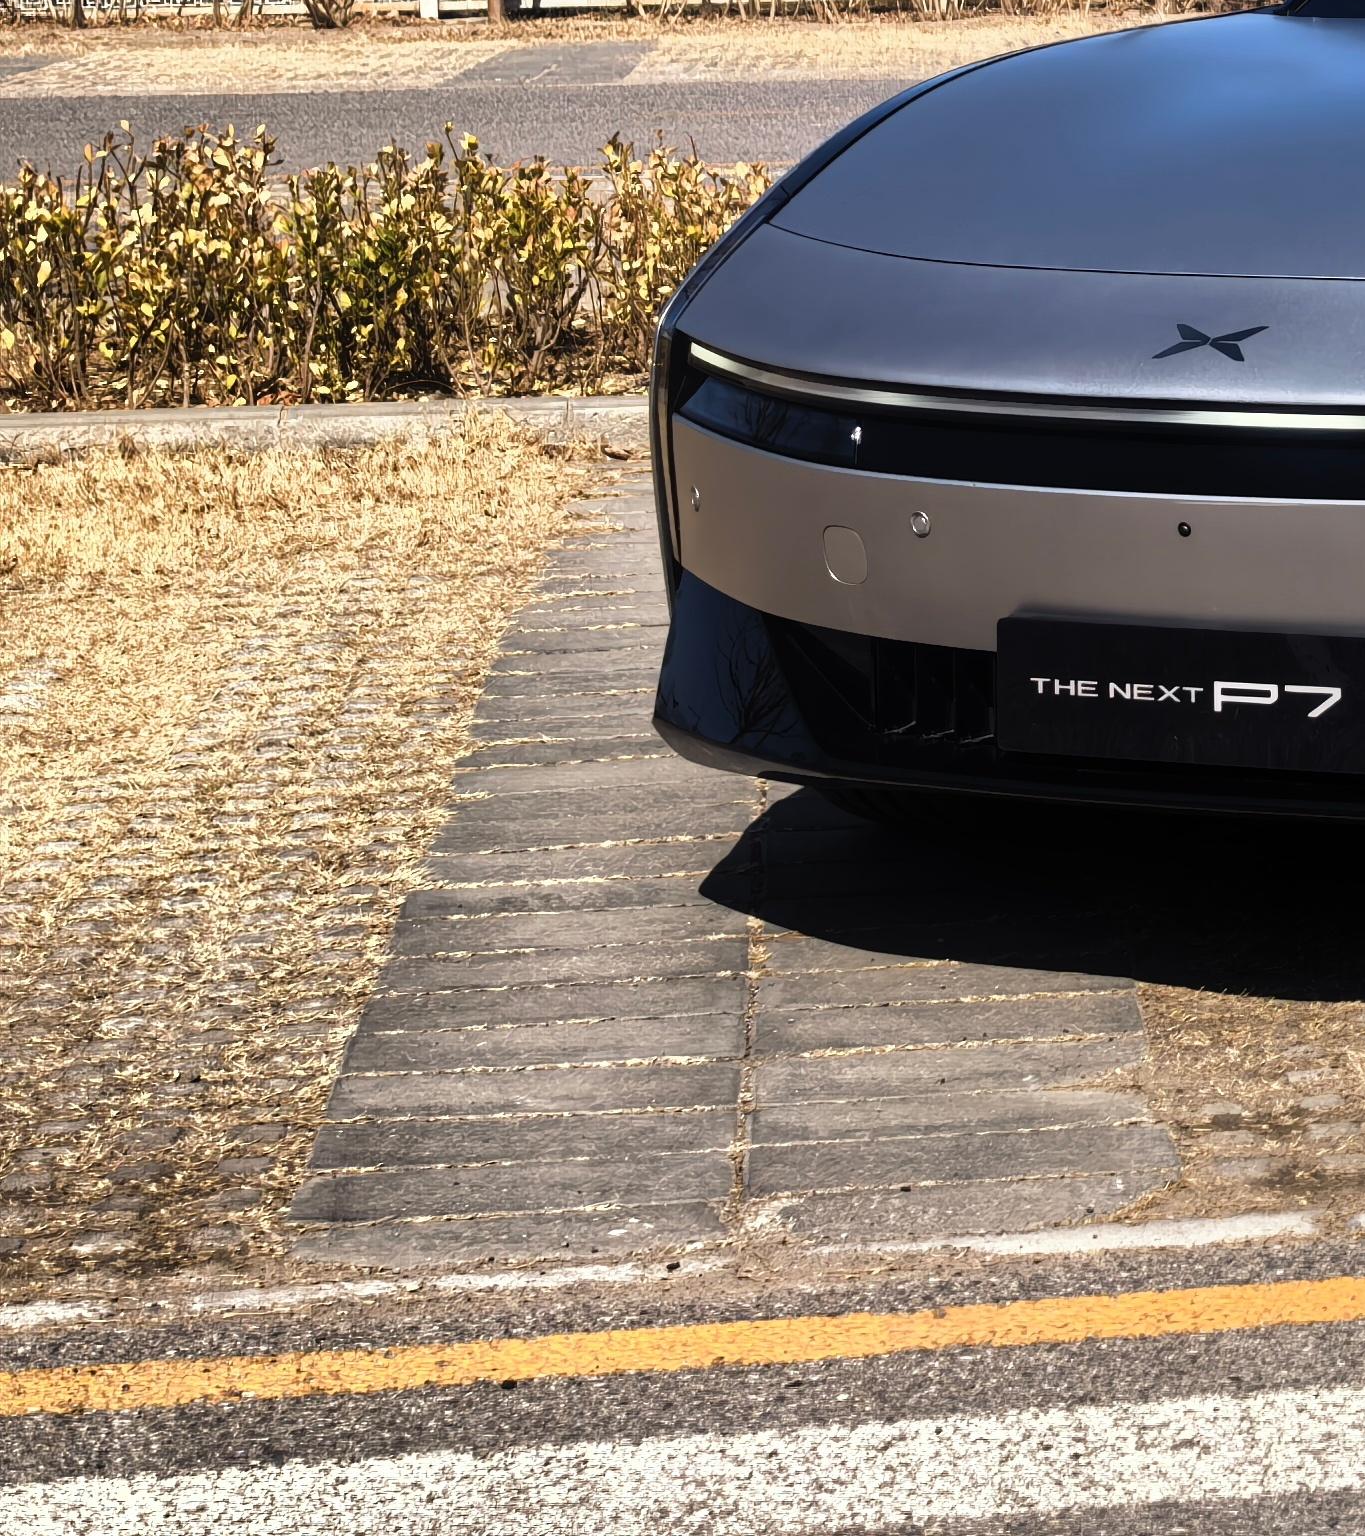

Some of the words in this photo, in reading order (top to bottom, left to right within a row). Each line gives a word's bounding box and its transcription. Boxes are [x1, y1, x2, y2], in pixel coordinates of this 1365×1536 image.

[1029, 677, 1099, 697] THE
[1108, 682, 1204, 703] NEXT
[1213, 680, 1343, 718] P7
